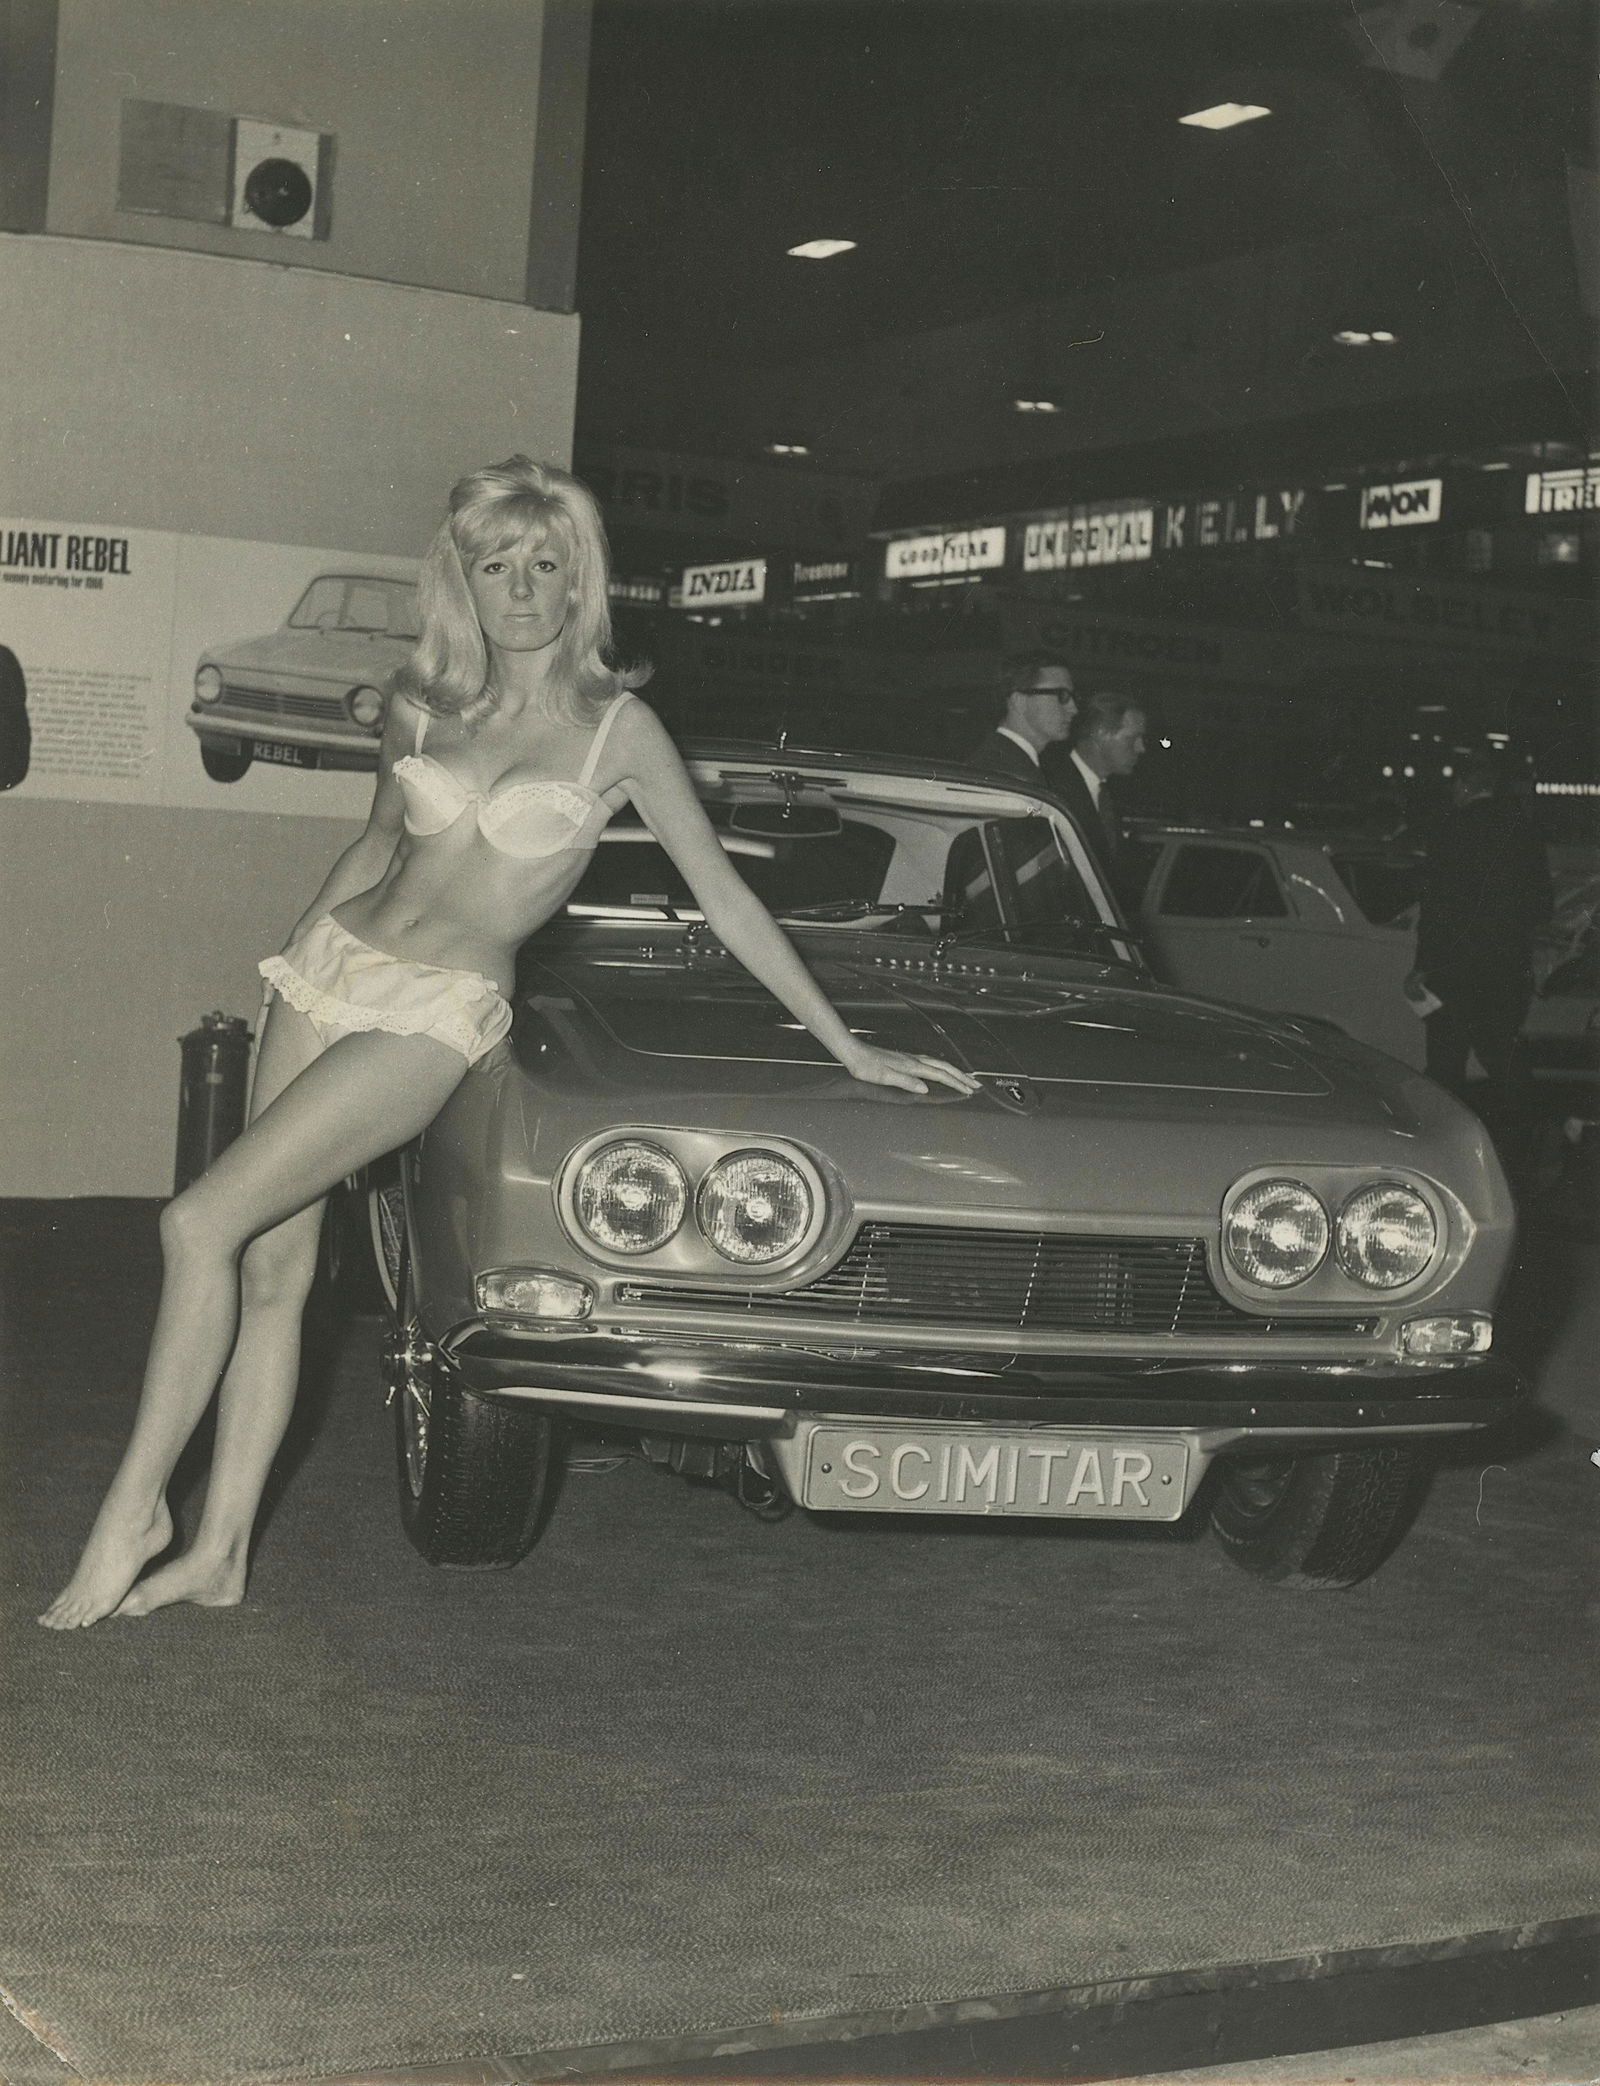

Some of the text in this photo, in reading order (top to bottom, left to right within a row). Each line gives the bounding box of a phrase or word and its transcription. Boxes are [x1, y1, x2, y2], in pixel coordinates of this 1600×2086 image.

[1164, 489, 1304, 549] KELLY
[66, 535, 131, 575] REBEL
[689, 566, 756, 596] INDIA
[1041, 622, 1222, 664] CITROEN
[253, 741, 303, 764] REBEL
[838, 1440, 1154, 1507] SCIMITAR
